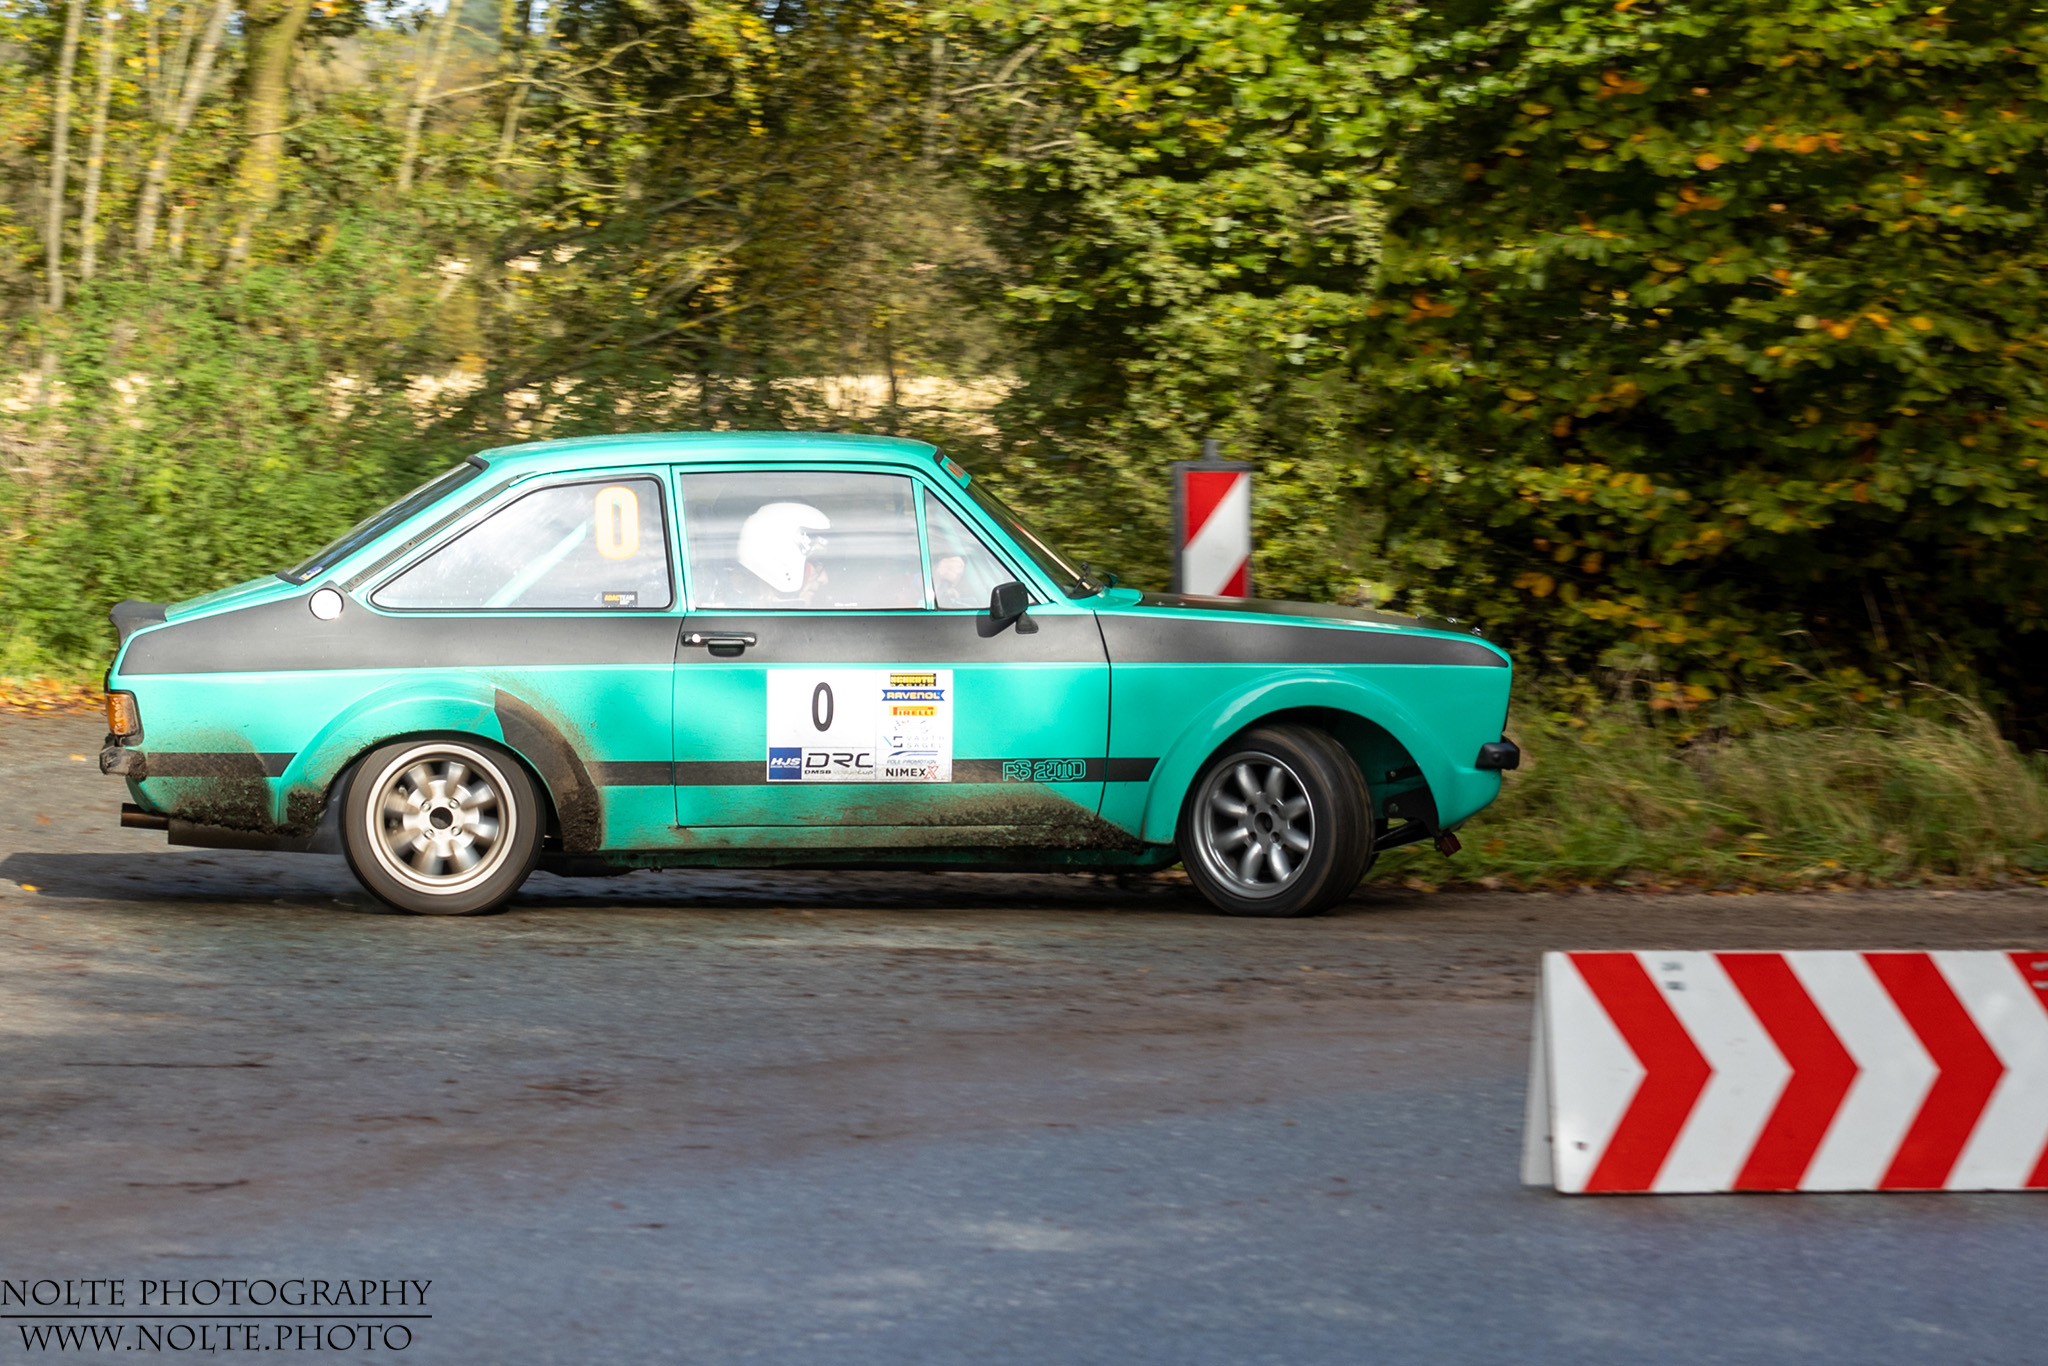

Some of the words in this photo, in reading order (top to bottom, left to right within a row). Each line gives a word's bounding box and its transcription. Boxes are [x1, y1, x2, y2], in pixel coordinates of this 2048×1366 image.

[595, 486, 640, 560] 0
[886, 691, 940, 699] RAVENOL
[812, 681, 834, 732] 0
[892, 706, 934, 716] PIRELLI
[770, 757, 801, 765] HJS
[805, 752, 874, 768] DRC
[1002, 759, 1032, 782] RS
[1033, 758, 1086, 782] 2000
